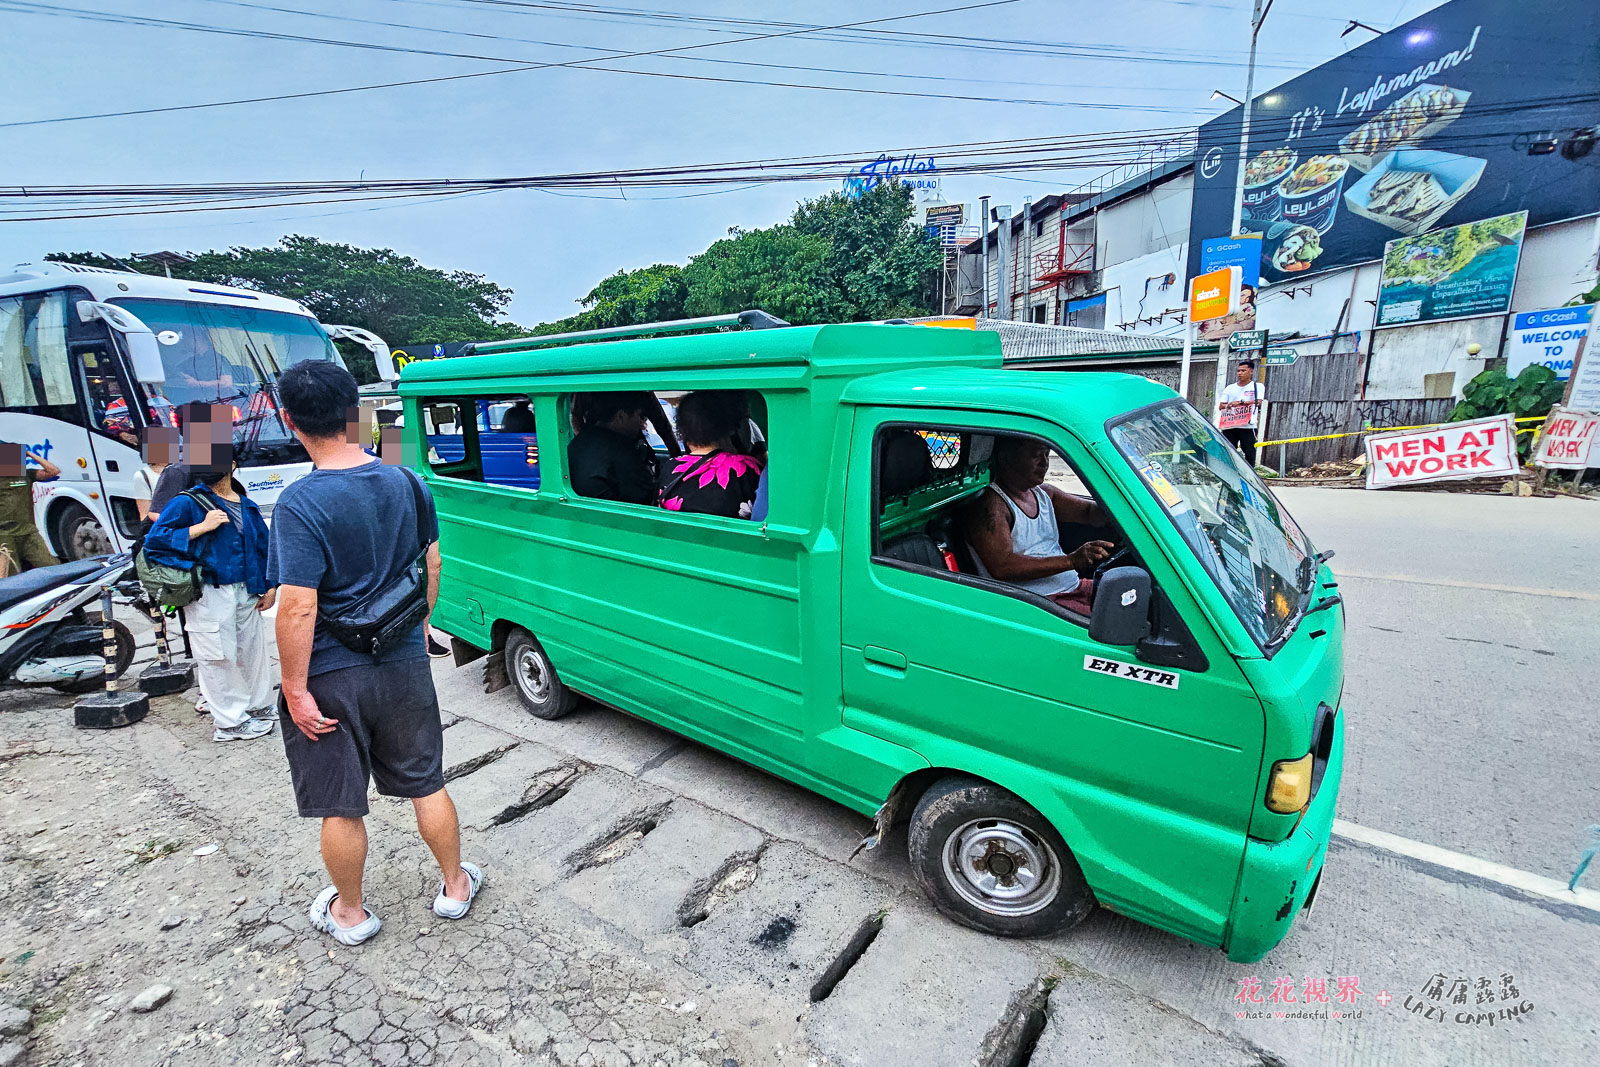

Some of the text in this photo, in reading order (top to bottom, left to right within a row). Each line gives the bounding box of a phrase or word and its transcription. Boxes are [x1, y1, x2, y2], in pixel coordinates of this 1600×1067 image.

[1216, 243, 1241, 252] GCash
[1542, 311, 1578, 323] GCash
[1522, 329, 1587, 344] WELCOM
[1544, 346, 1563, 356] TO
[1375, 427, 1501, 461] MEN AT
[1547, 440, 1583, 458] WORK
[1385, 449, 1495, 478] WORK
[248, 479, 284, 489] Southwest
[1088, 658, 1176, 686] ER XTR
